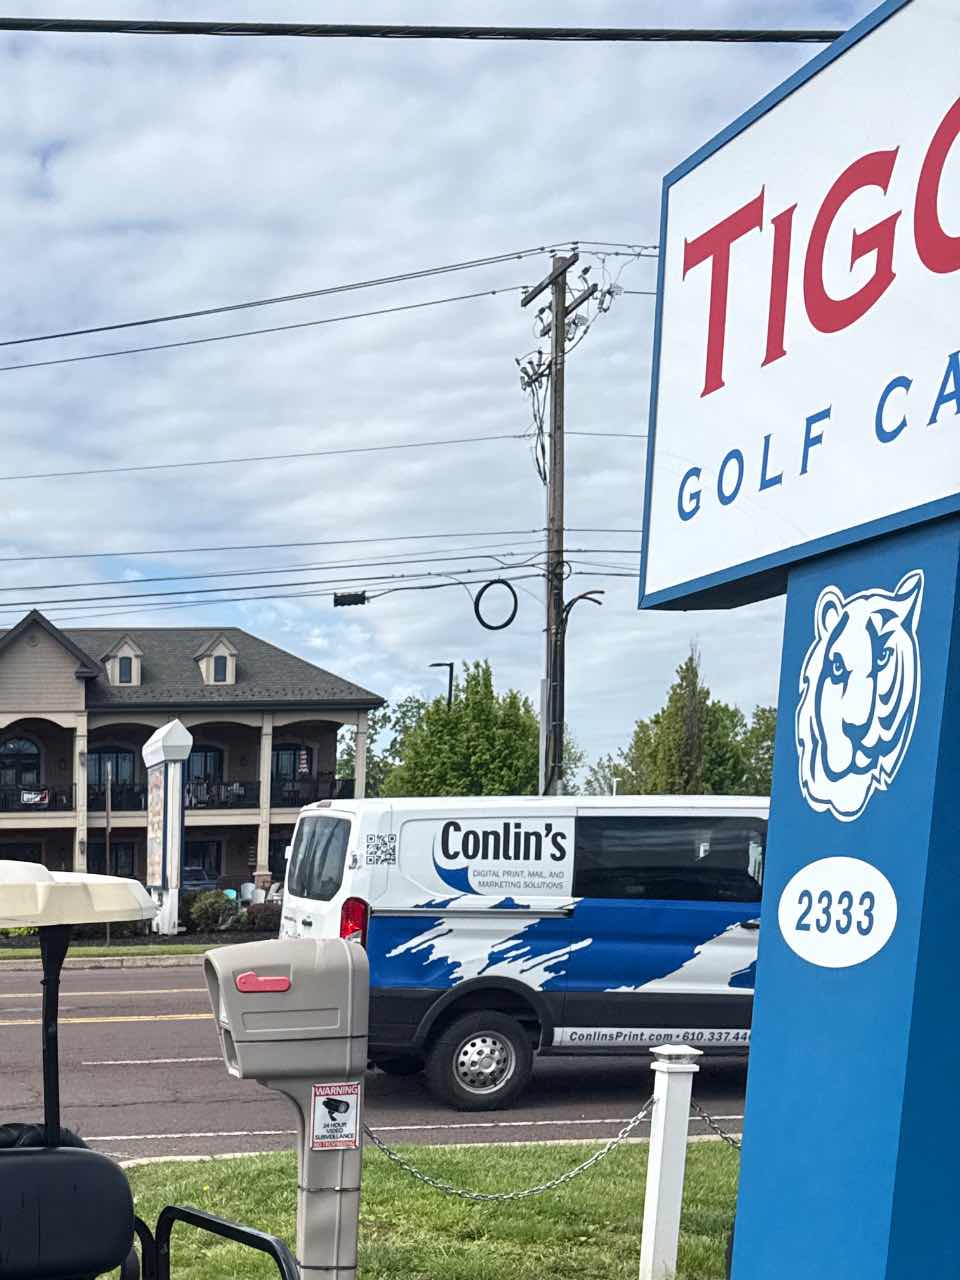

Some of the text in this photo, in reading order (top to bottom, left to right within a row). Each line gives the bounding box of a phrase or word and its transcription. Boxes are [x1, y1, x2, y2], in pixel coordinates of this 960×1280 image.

[677, 404, 832, 522] GOLF
[441, 821, 567, 861] Conlin's
[472, 870, 500, 878] DIGITAL
[549, 871, 565, 879] AND
[478, 881, 520, 889] MARKETING
[795, 889, 876, 936] 2333
[569, 1031, 751, 1042] ConlinsPrint.com 610.337.44
[315, 1085, 358, 1096] WARNING
